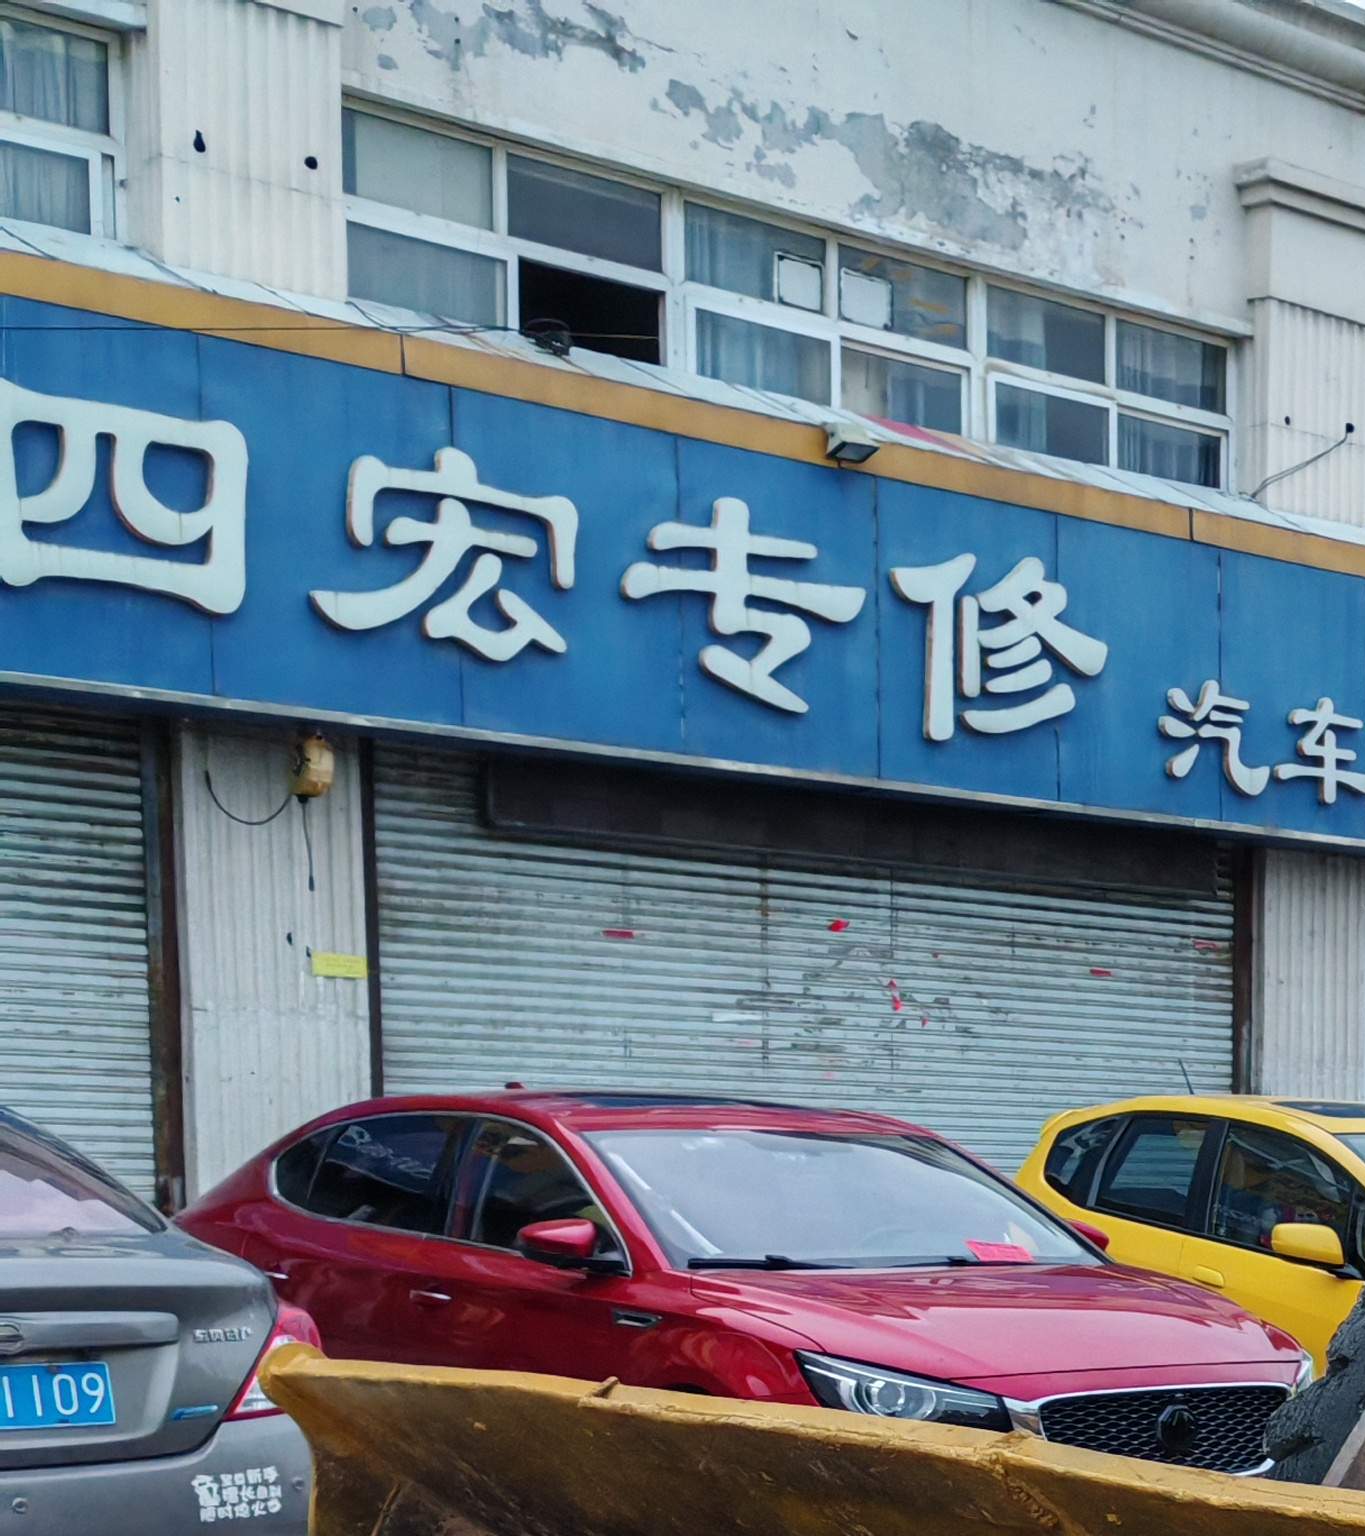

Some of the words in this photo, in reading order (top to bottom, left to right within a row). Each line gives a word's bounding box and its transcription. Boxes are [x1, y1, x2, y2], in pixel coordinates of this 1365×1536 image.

[0, 377, 1108, 742] 四宏专修
[2, 1372, 105, 1418] 1109
